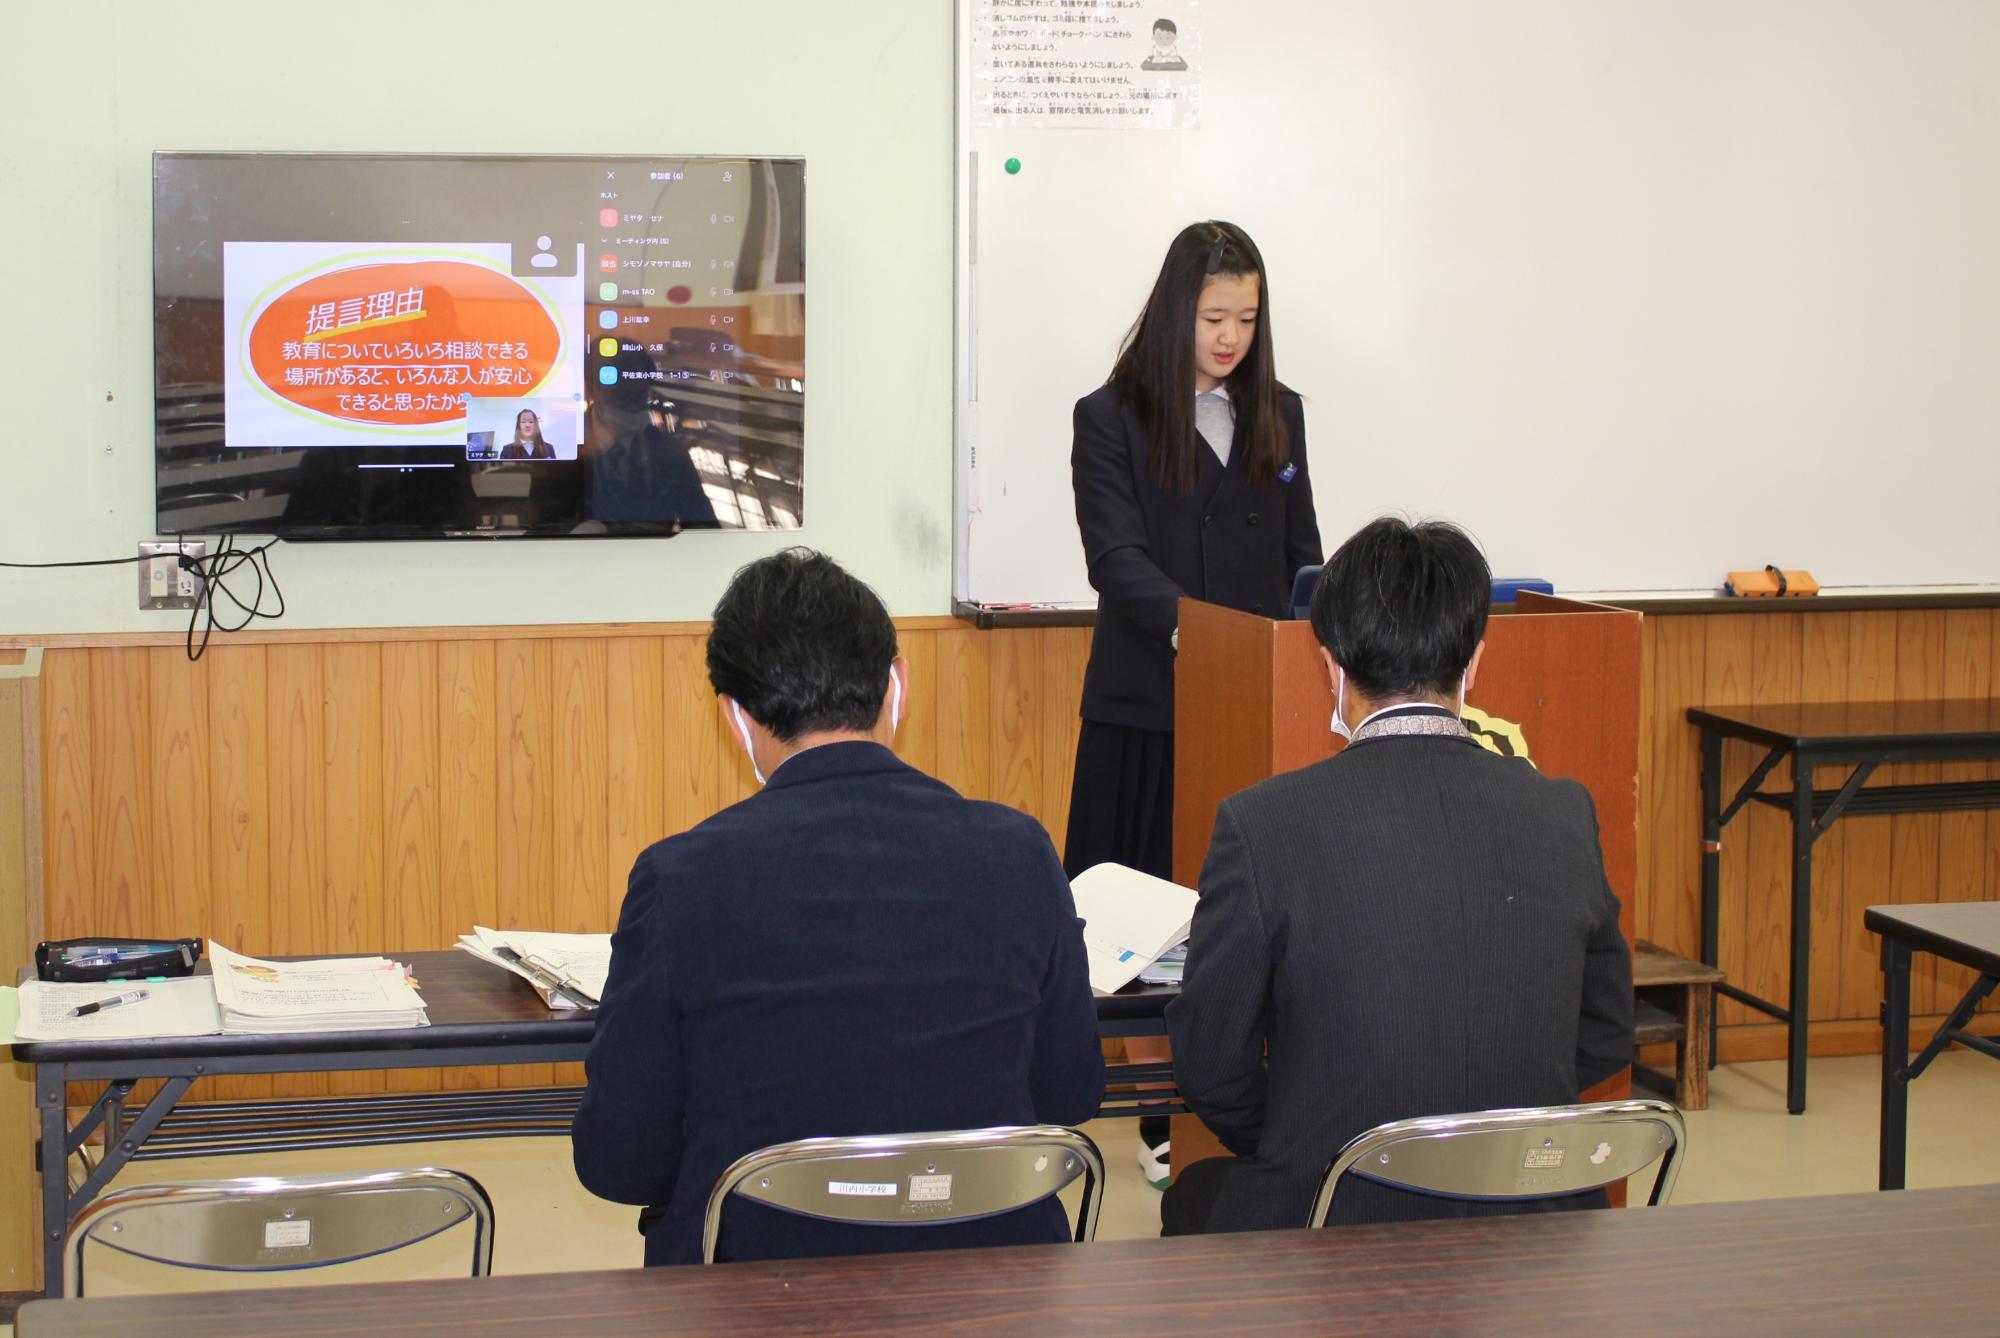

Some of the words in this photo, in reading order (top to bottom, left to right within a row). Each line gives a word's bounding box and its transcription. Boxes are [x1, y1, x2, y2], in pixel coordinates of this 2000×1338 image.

[623, 214, 643, 222] ミヤタ
[650, 214, 664, 222] セナ
[305, 287, 424, 335] 提言理由
[282, 340, 529, 360] 教育についていろいろ相談できる
[284, 367, 533, 386] 場所があると、いろんな人が安心
